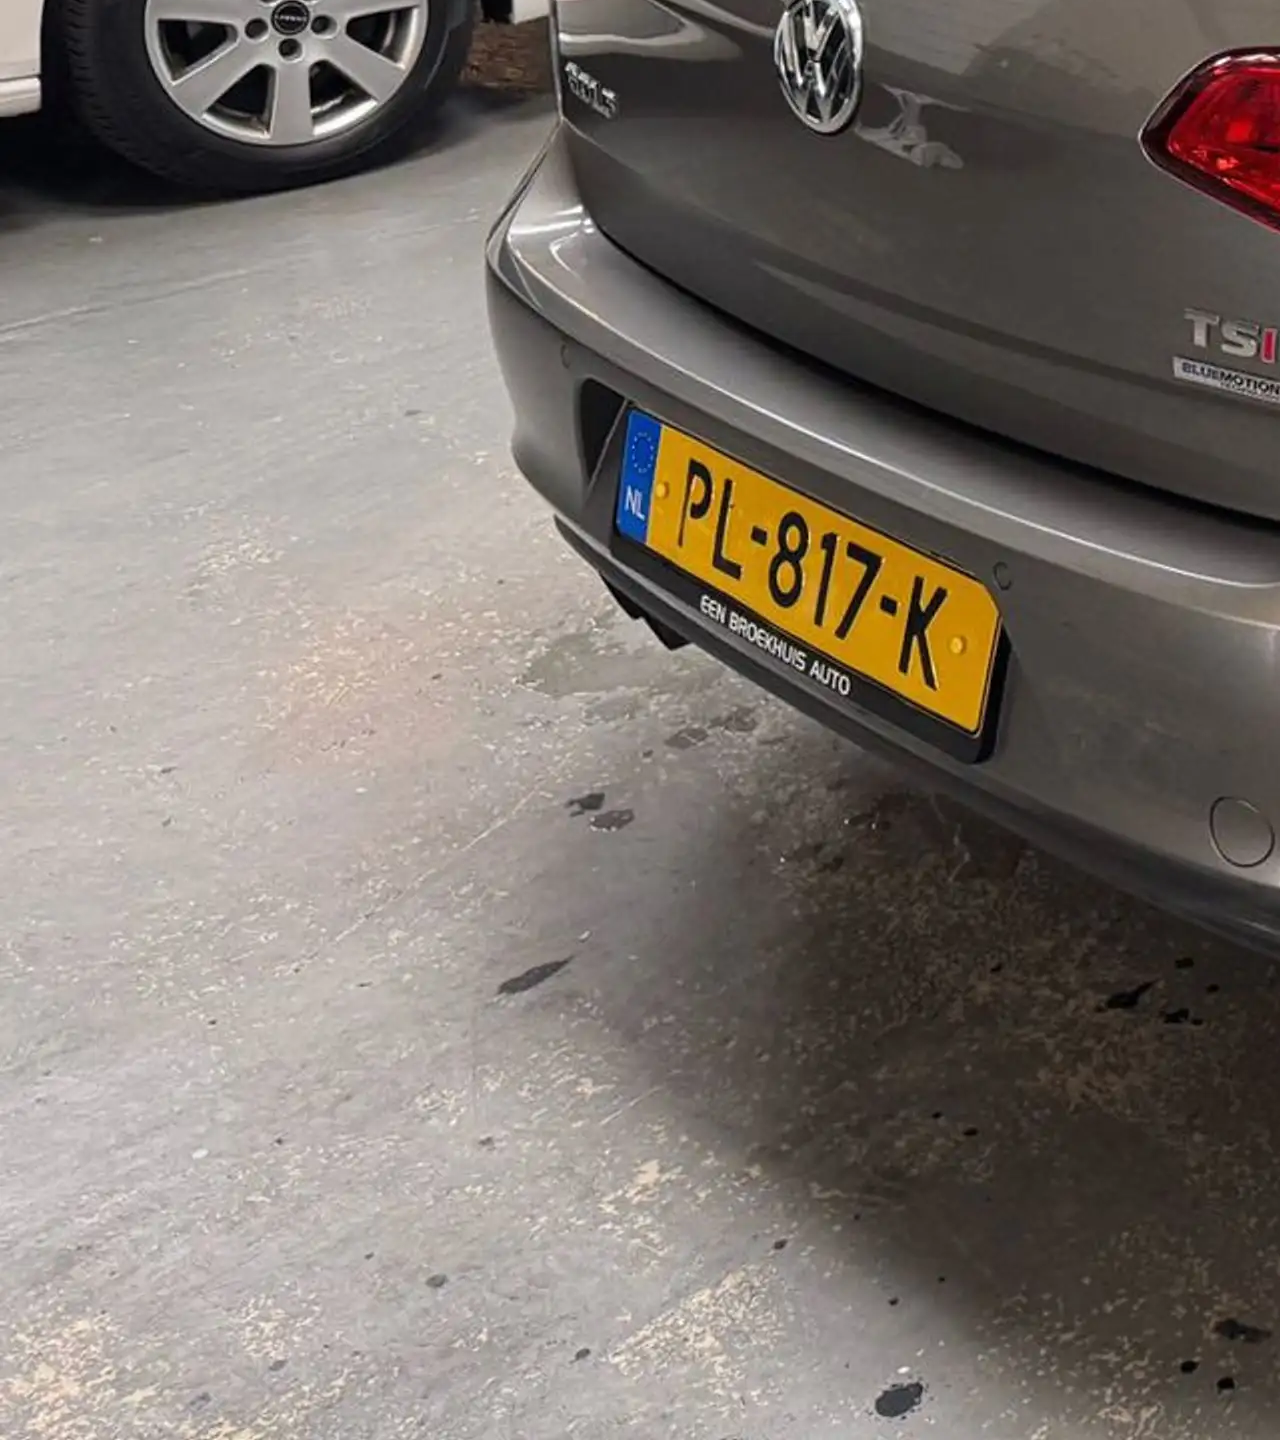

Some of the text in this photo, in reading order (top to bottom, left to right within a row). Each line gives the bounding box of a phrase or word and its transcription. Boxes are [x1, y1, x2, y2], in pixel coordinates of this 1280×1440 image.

[1183, 307, 1278, 365] TSI
[1181, 361, 1280, 396] BLUEMOTION
[625, 483, 646, 521] NL
[676, 456, 948, 692] PL-817-K
[700, 594, 852, 697] EEN BROEKHUIS AUTO
